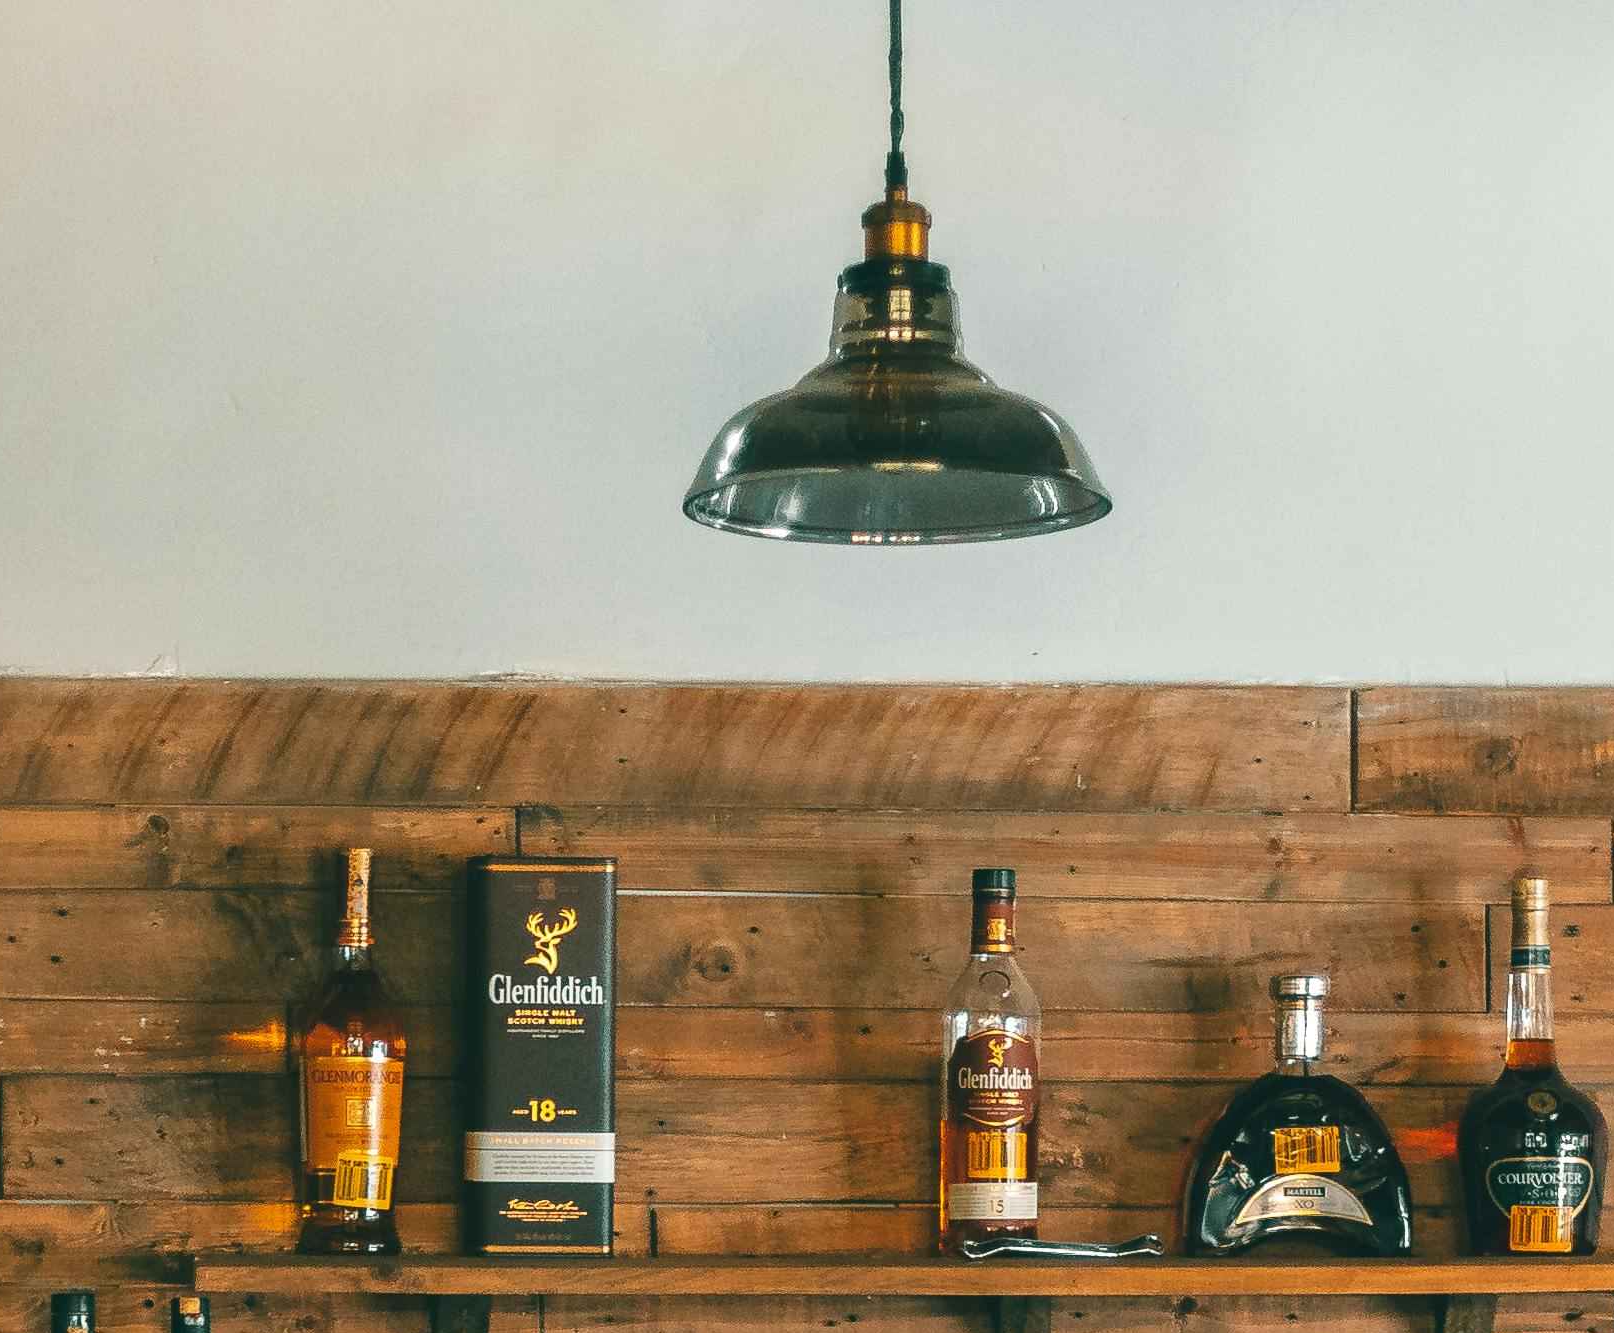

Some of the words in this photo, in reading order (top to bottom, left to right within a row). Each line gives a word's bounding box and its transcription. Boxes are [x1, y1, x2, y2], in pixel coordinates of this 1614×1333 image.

[488, 973, 604, 1005] Glenfiddich
[958, 1066, 1033, 1090] Glenfiddich
[529, 1099, 556, 1123] 18
[1295, 1200, 1314, 1209] XO
